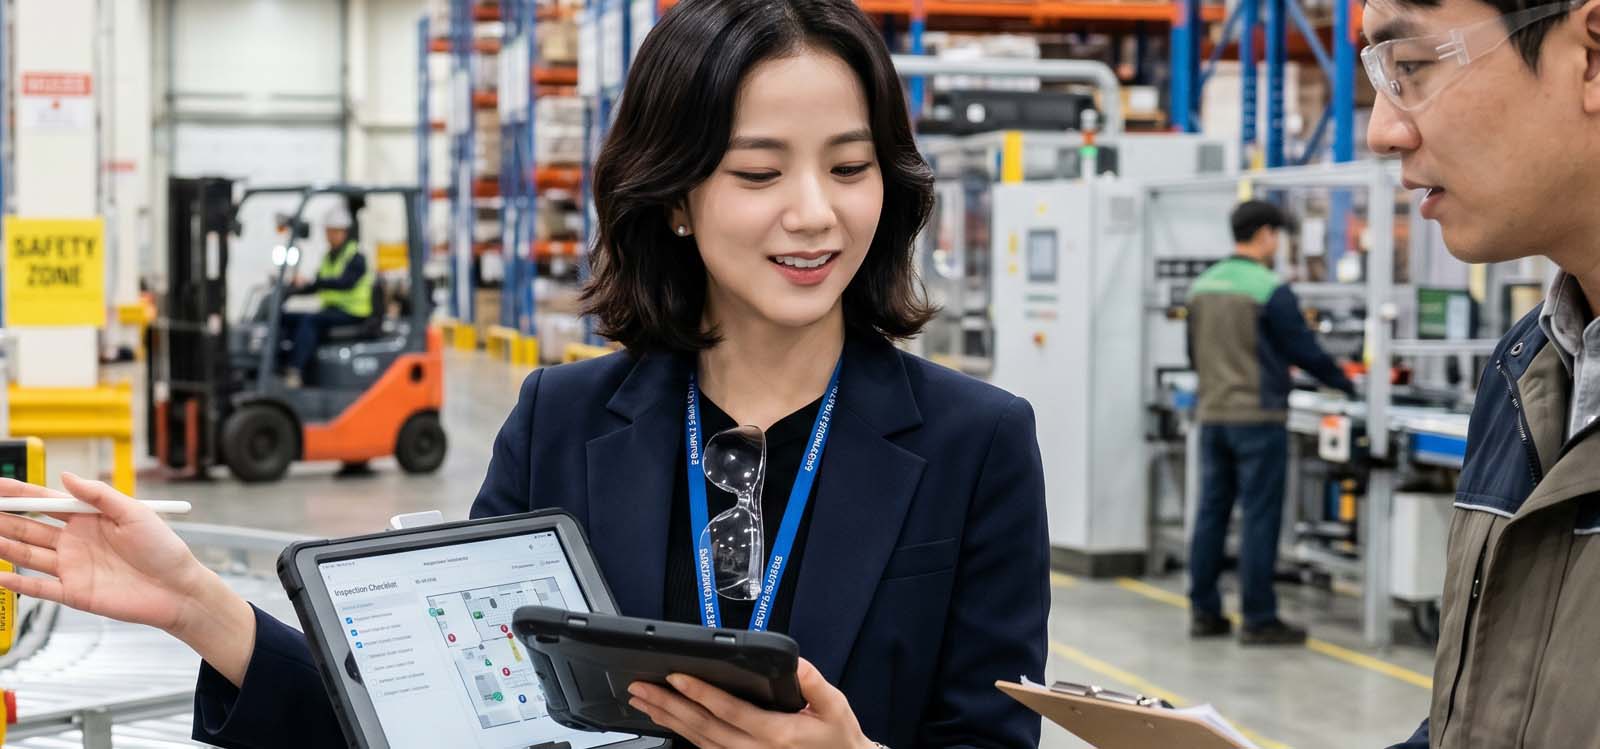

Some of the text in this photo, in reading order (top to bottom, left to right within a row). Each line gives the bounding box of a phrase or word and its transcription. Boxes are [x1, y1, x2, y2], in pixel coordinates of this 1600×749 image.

[14, 235, 97, 259] SAFETY
[27, 264, 82, 288] ZONE
[334, 585, 367, 597] Inspection
